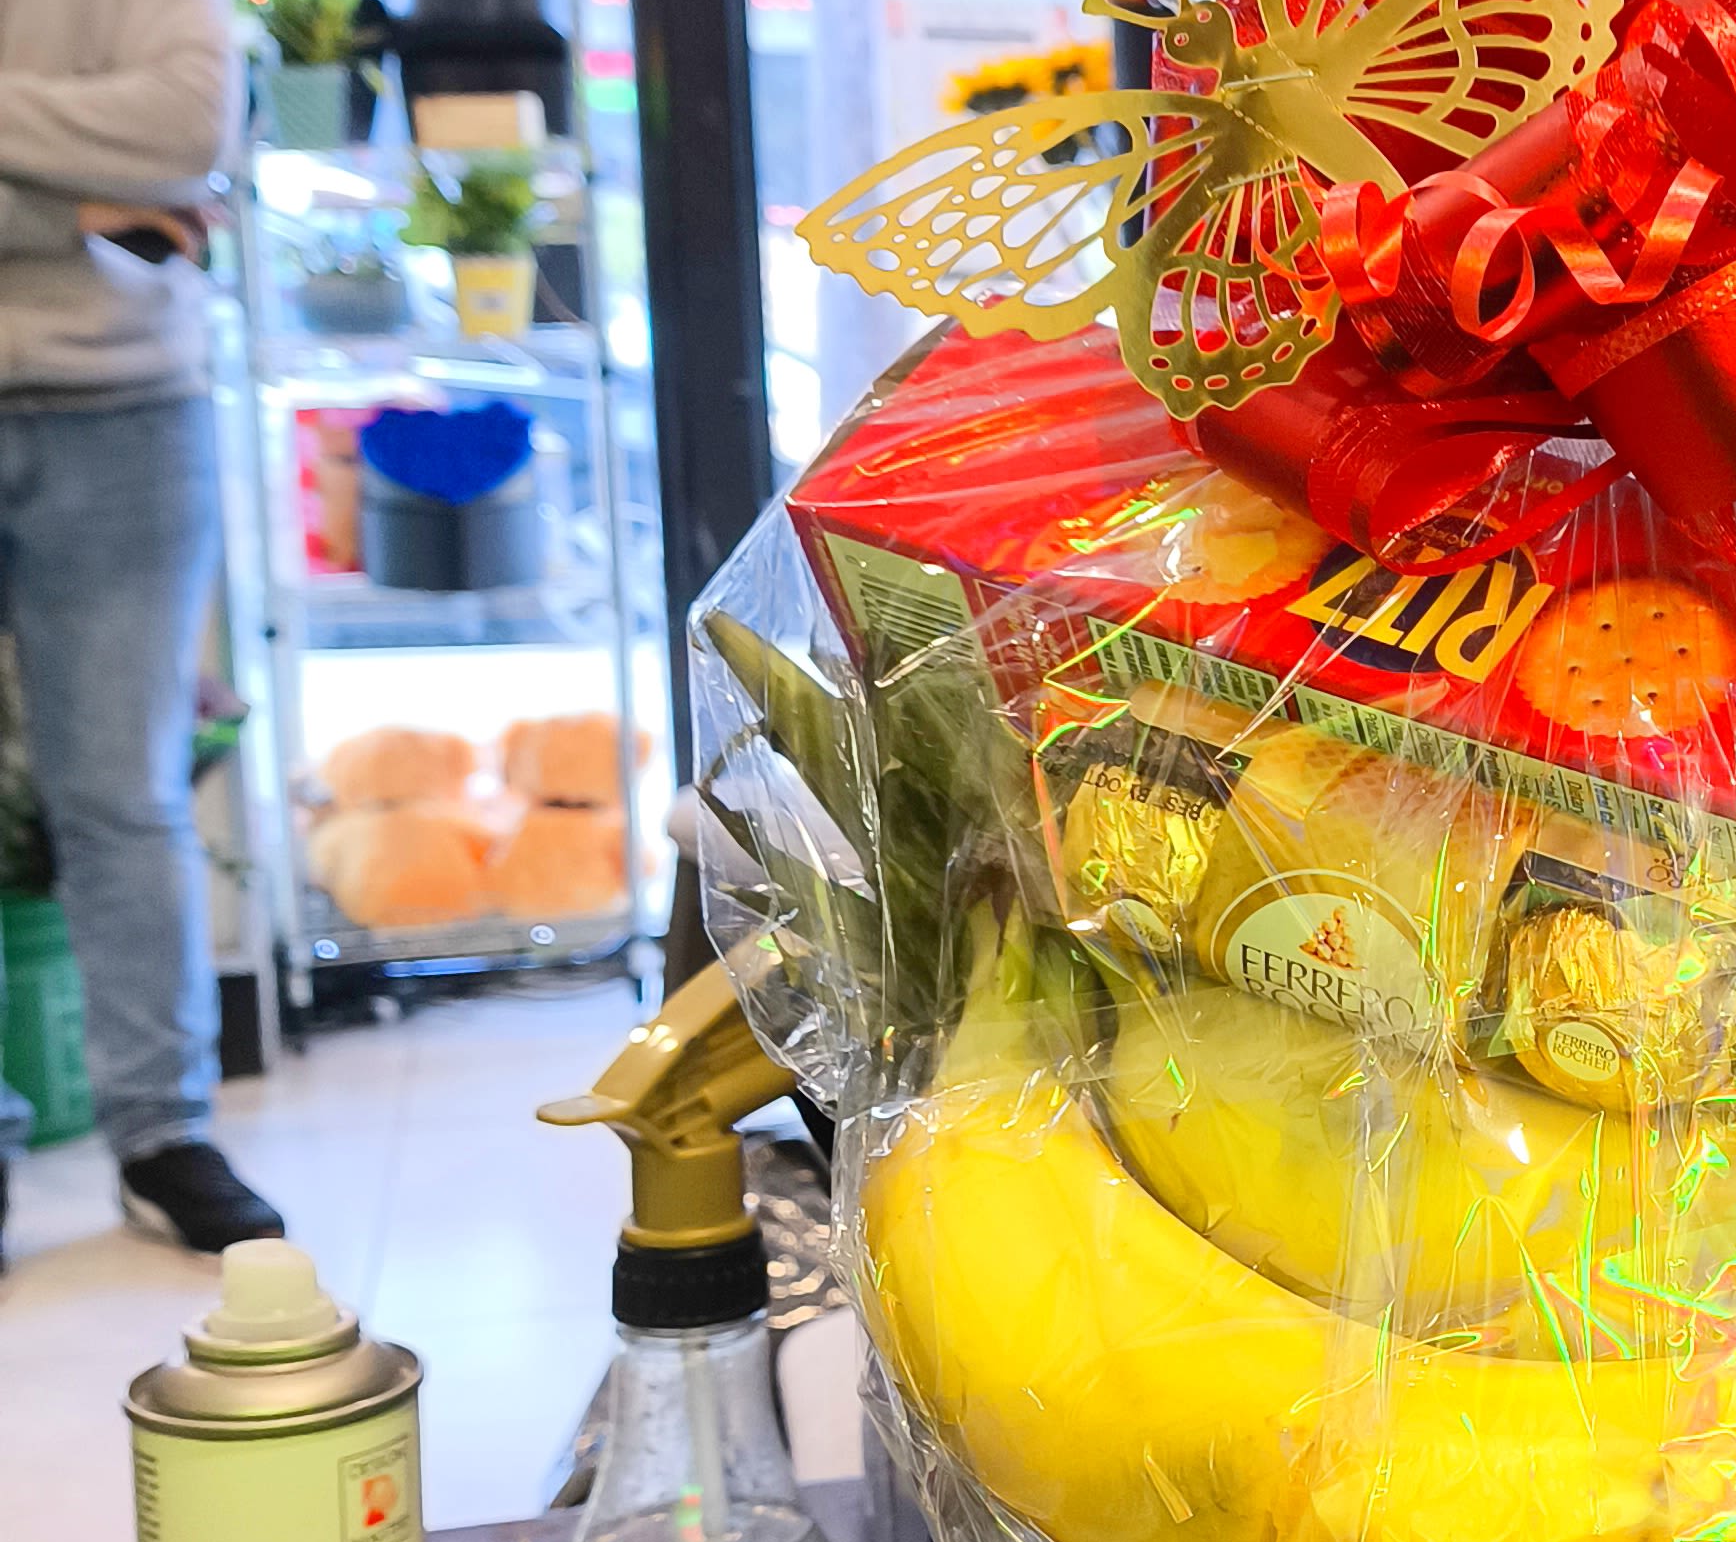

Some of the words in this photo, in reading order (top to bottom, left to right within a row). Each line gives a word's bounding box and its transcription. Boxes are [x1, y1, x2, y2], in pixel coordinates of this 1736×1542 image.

[1282, 554, 1556, 685] RITZ
[1241, 942, 1418, 1033] FERRERO
[1551, 1043, 1613, 1074] ROCHER
[1553, 1030, 1618, 1062] FERRERO
